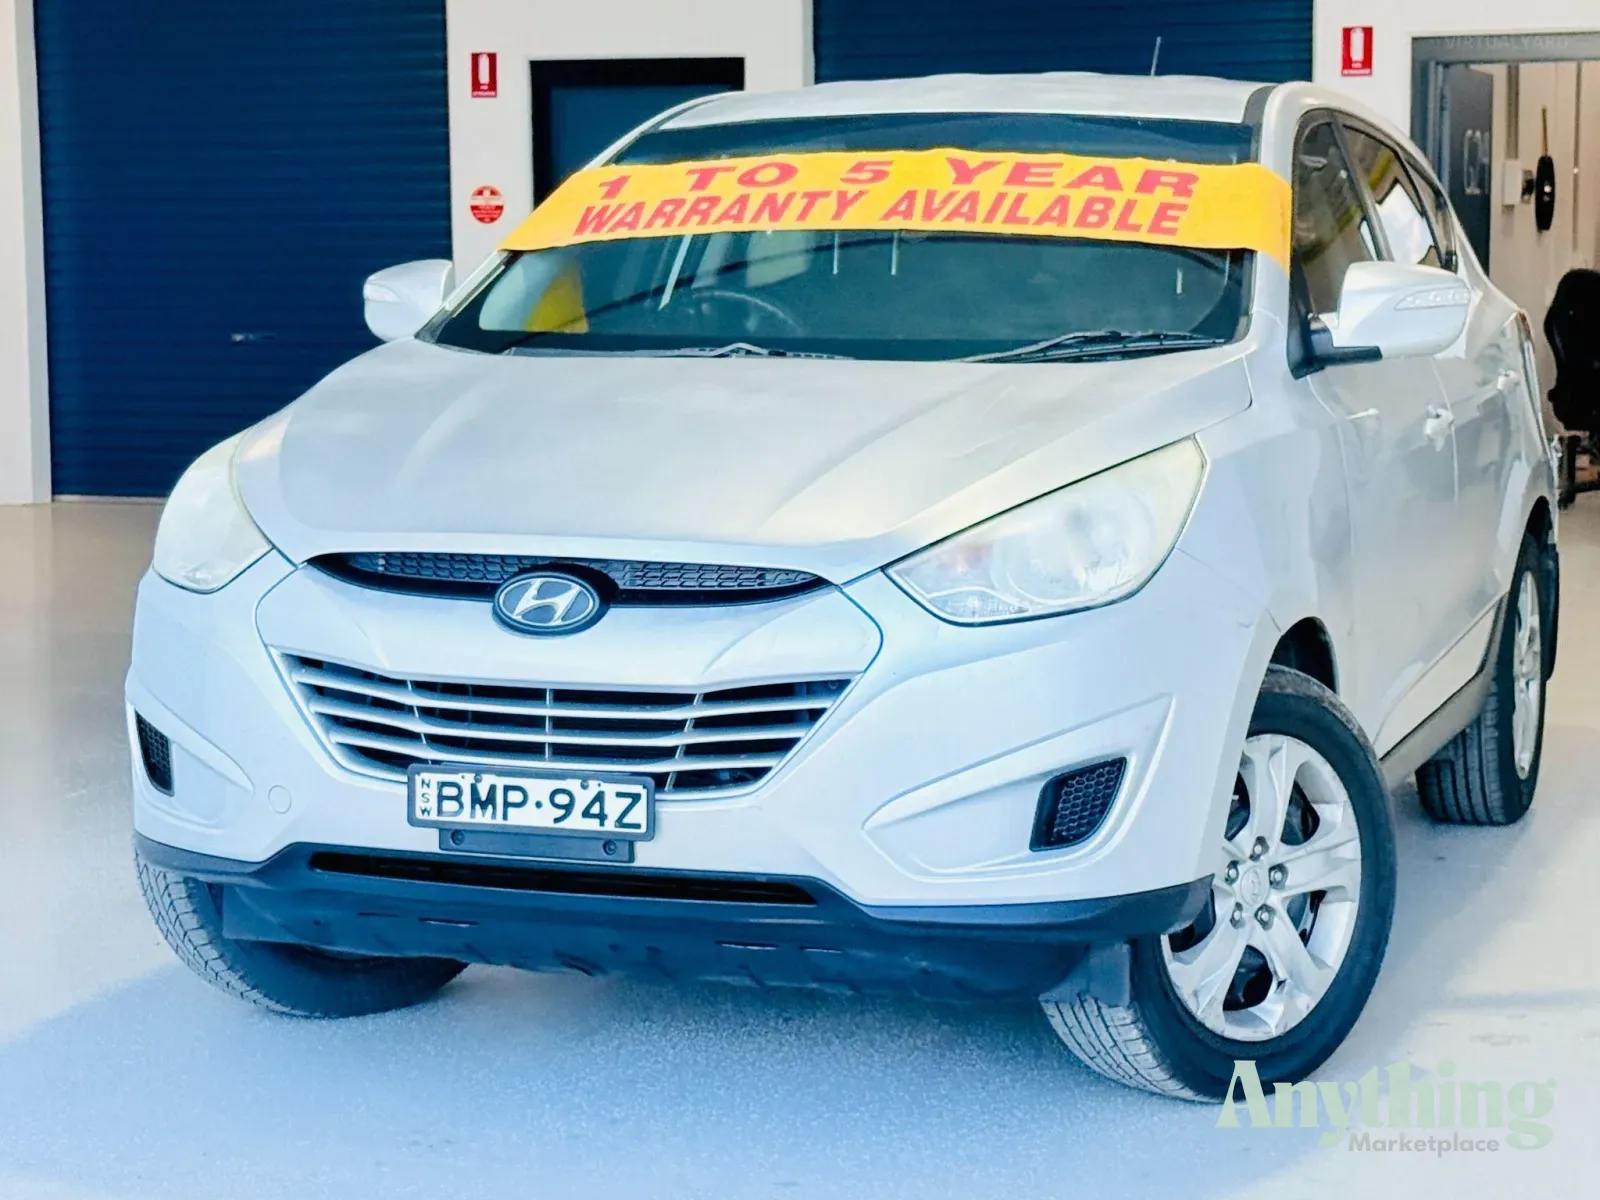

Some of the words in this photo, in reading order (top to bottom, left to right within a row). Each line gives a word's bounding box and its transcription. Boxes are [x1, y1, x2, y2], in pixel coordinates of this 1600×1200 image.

[598, 174, 632, 200] 1
[686, 161, 798, 191] TO
[840, 160, 893, 184] 5
[946, 157, 1200, 197] YEAR
[574, 190, 867, 235] WARRANTY
[879, 190, 1188, 235] AVAILABLE
[420, 778, 432, 817] NSW
